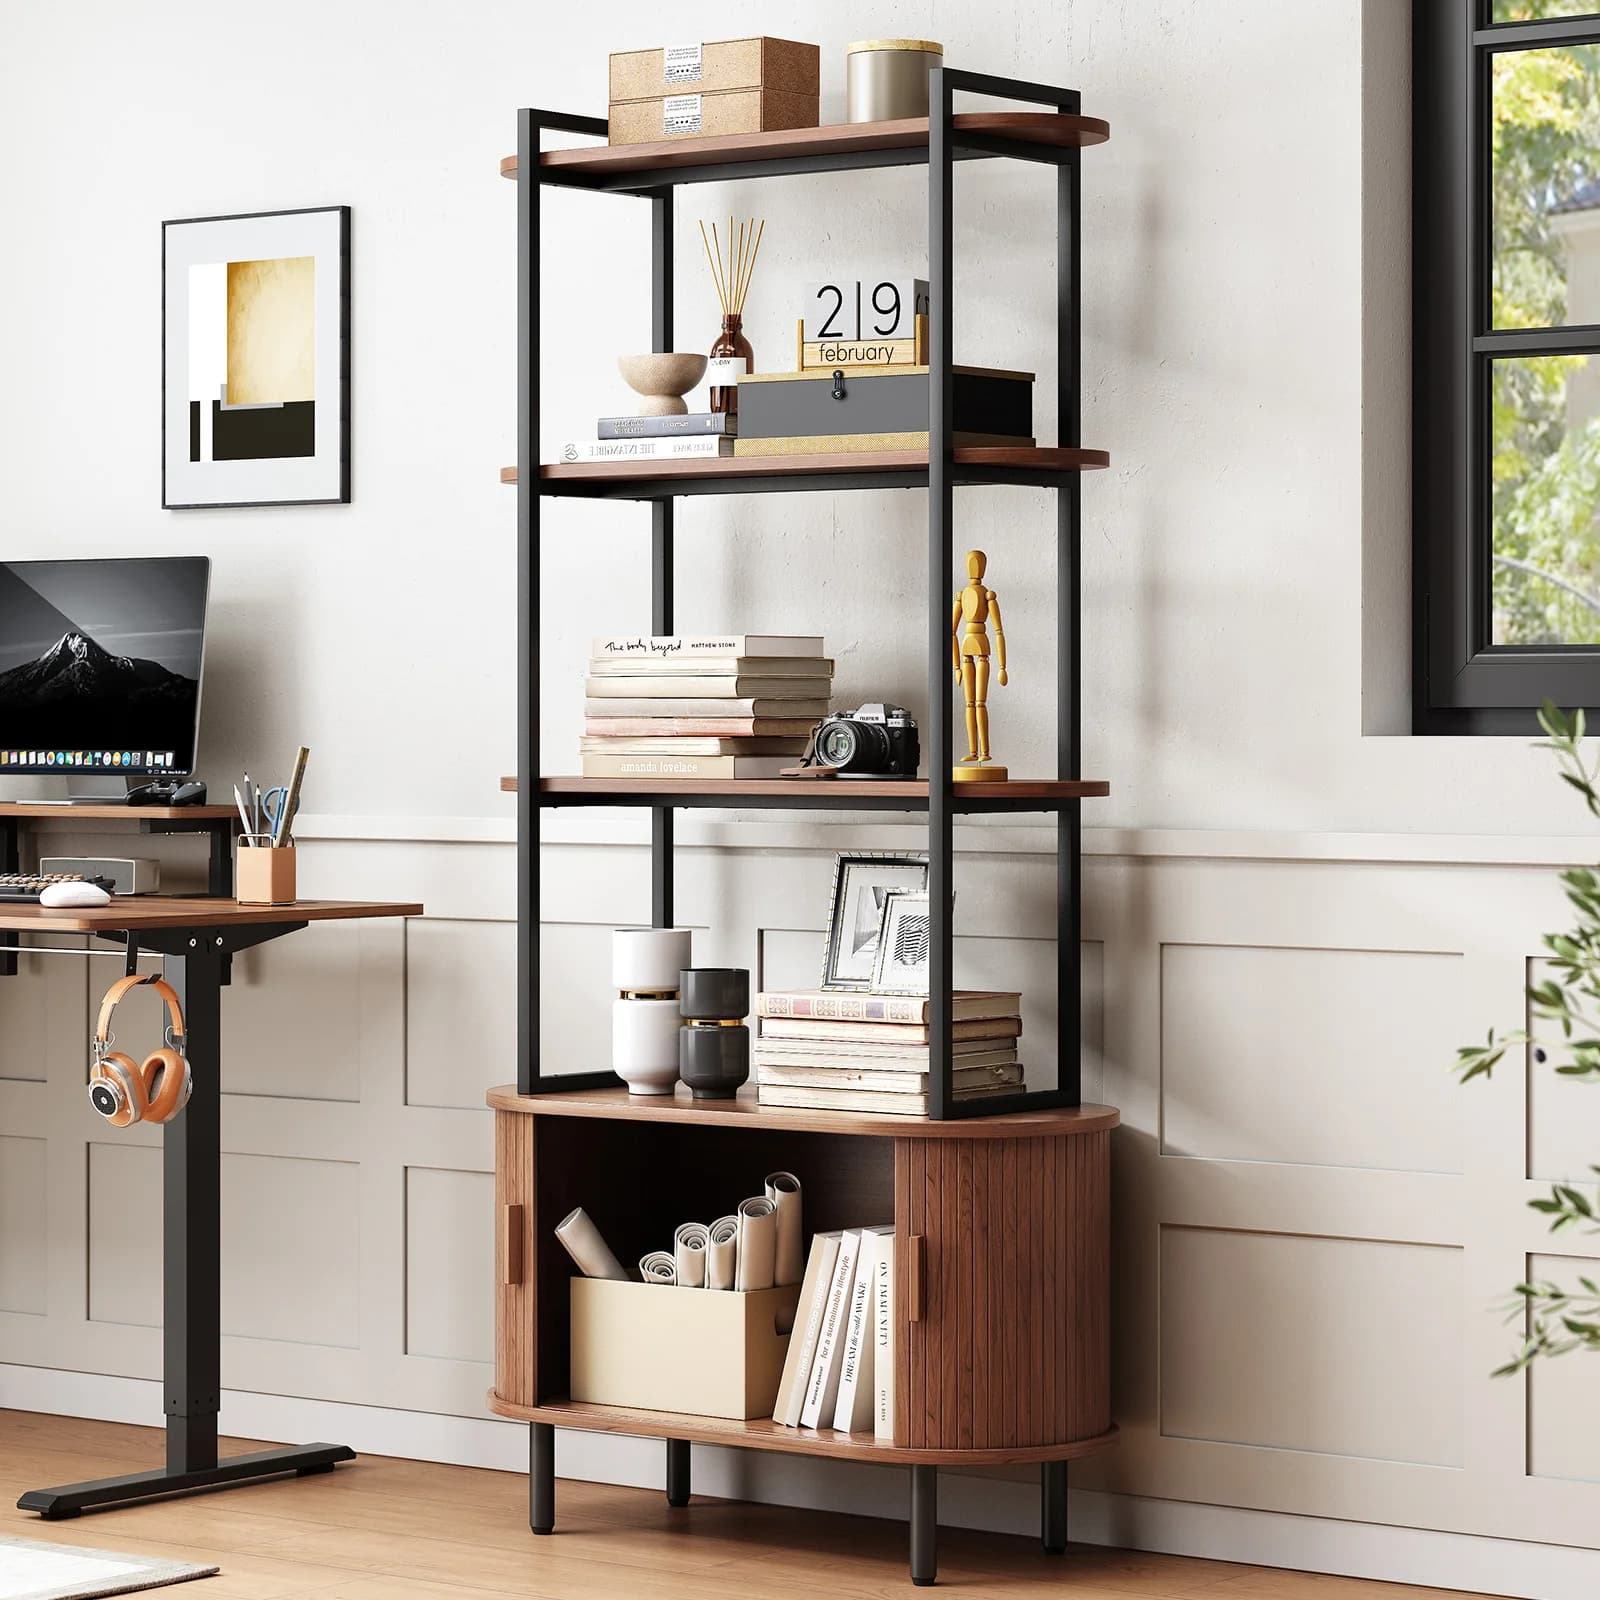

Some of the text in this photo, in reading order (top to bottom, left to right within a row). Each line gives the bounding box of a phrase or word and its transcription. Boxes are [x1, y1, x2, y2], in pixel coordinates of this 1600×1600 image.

[818, 342, 895, 365] february
[604, 638, 682, 657] The body beyond
[620, 760, 697, 773] amanda lovelace
[820, 1346, 829, 1359] for
[825, 1289, 842, 1338] sustainable
[836, 1255, 850, 1288] lifestyle
[855, 1281, 867, 1317] AWAKE
[879, 1262, 888, 1349] ON IMMUNITY
[850, 1337, 858, 1347] the
[845, 1346, 857, 1383] DREAM
